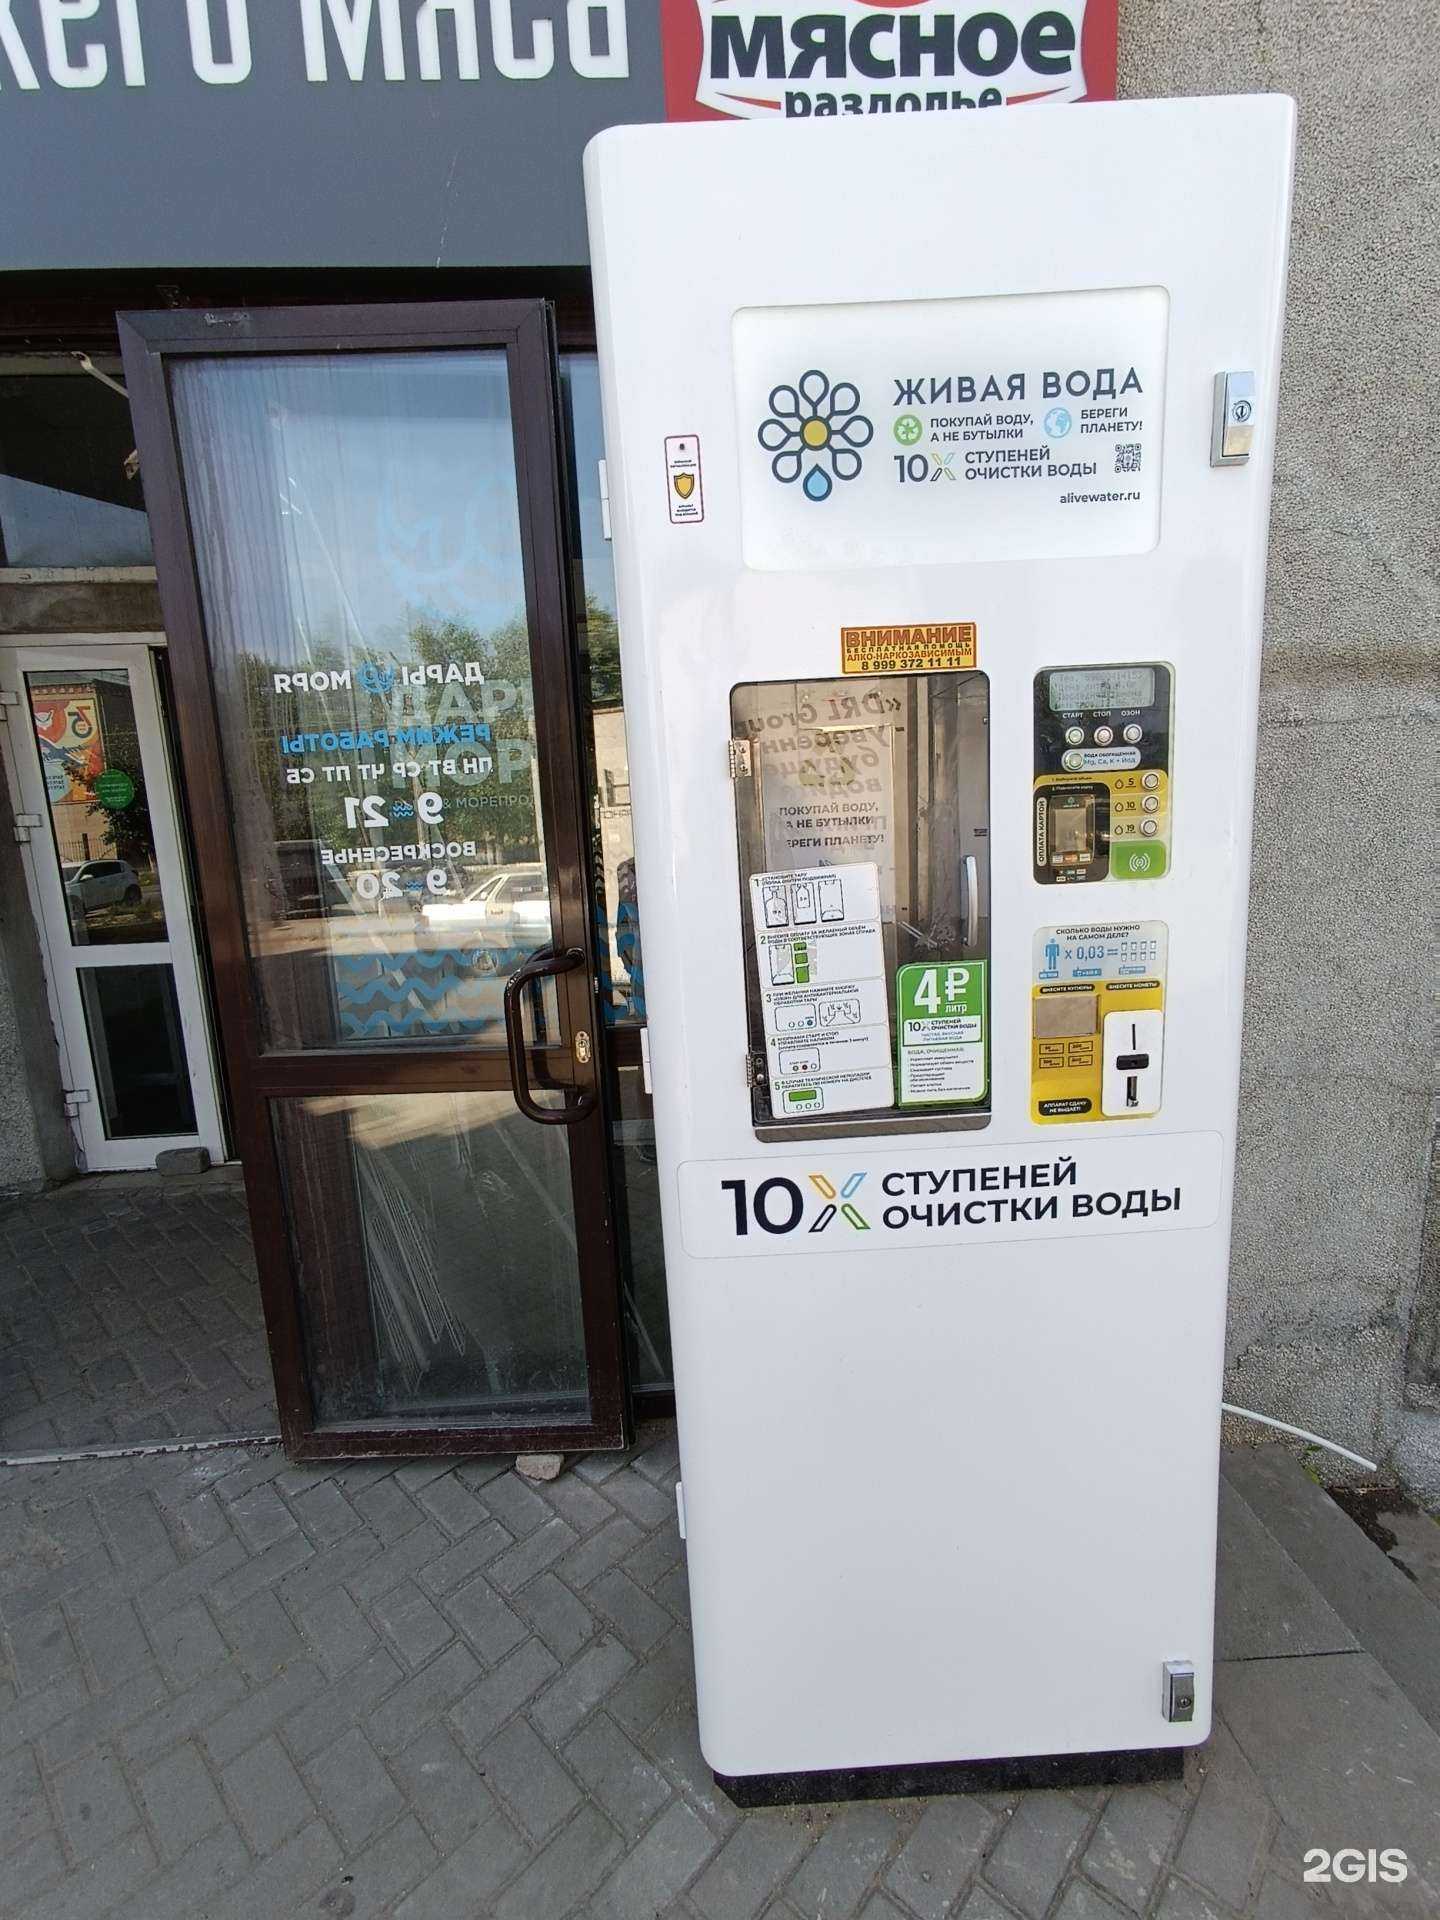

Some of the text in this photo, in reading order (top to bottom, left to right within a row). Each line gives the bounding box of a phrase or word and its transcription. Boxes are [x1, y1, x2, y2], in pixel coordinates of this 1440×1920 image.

[893, 367, 1144, 407] ЖИВАЯ ВОДА
[930, 412, 1034, 429] ПОКУПАЙ ВОДУ,
[1080, 406, 1129, 420] БЕРЕГИ
[930, 427, 1024, 443] А НЕ БУТЫЛКИ
[1080, 420, 1143, 435] ПЛАНЕТУ!
[964, 445, 1050, 465] СТУПЕНЕЙ
[964, 461, 1097, 481] ОЧИСТКИ ВОДЫ
[1059, 490, 1141, 505] alivewater.ru
[846, 626, 972, 648] ВНИМАНИЕ
[847, 642, 970, 654] БЕСПЛАТНАЯ ПОМОЩЬ
[847, 648, 972, 662] АЛКО-НАРКОЗАВИСИМЫМ
[861, 656, 961, 671] 8 999 372 11 11
[1128, 778, 1134, 786] 5
[779, 801, 879, 816] ПОКУПАЙ ВОДУ,
[1037, 800, 1045, 831] КАРТОЙ
[796, 819, 813, 829] НЕ
[815, 816, 875, 828] БУТЫЛКИ
[824, 834, 884, 847] ПЛАНЕТУ!
[1056, 927, 1089, 935] СКОЛЬКО
[1113, 924, 1140, 932] НУЖНО
[1106, 931, 1129, 939] ДЕЛЕ?
[760, 936, 766, 944] 2
[1076, 945, 1105, 961] 0,03
[766, 993, 772, 1003] 3
[774, 1081, 781, 1090] 5
[881, 1156, 1077, 1197] СТУПЕНЕЙ
[881, 1187, 1181, 1229] ОЧИСТКИ ВОДЫ
